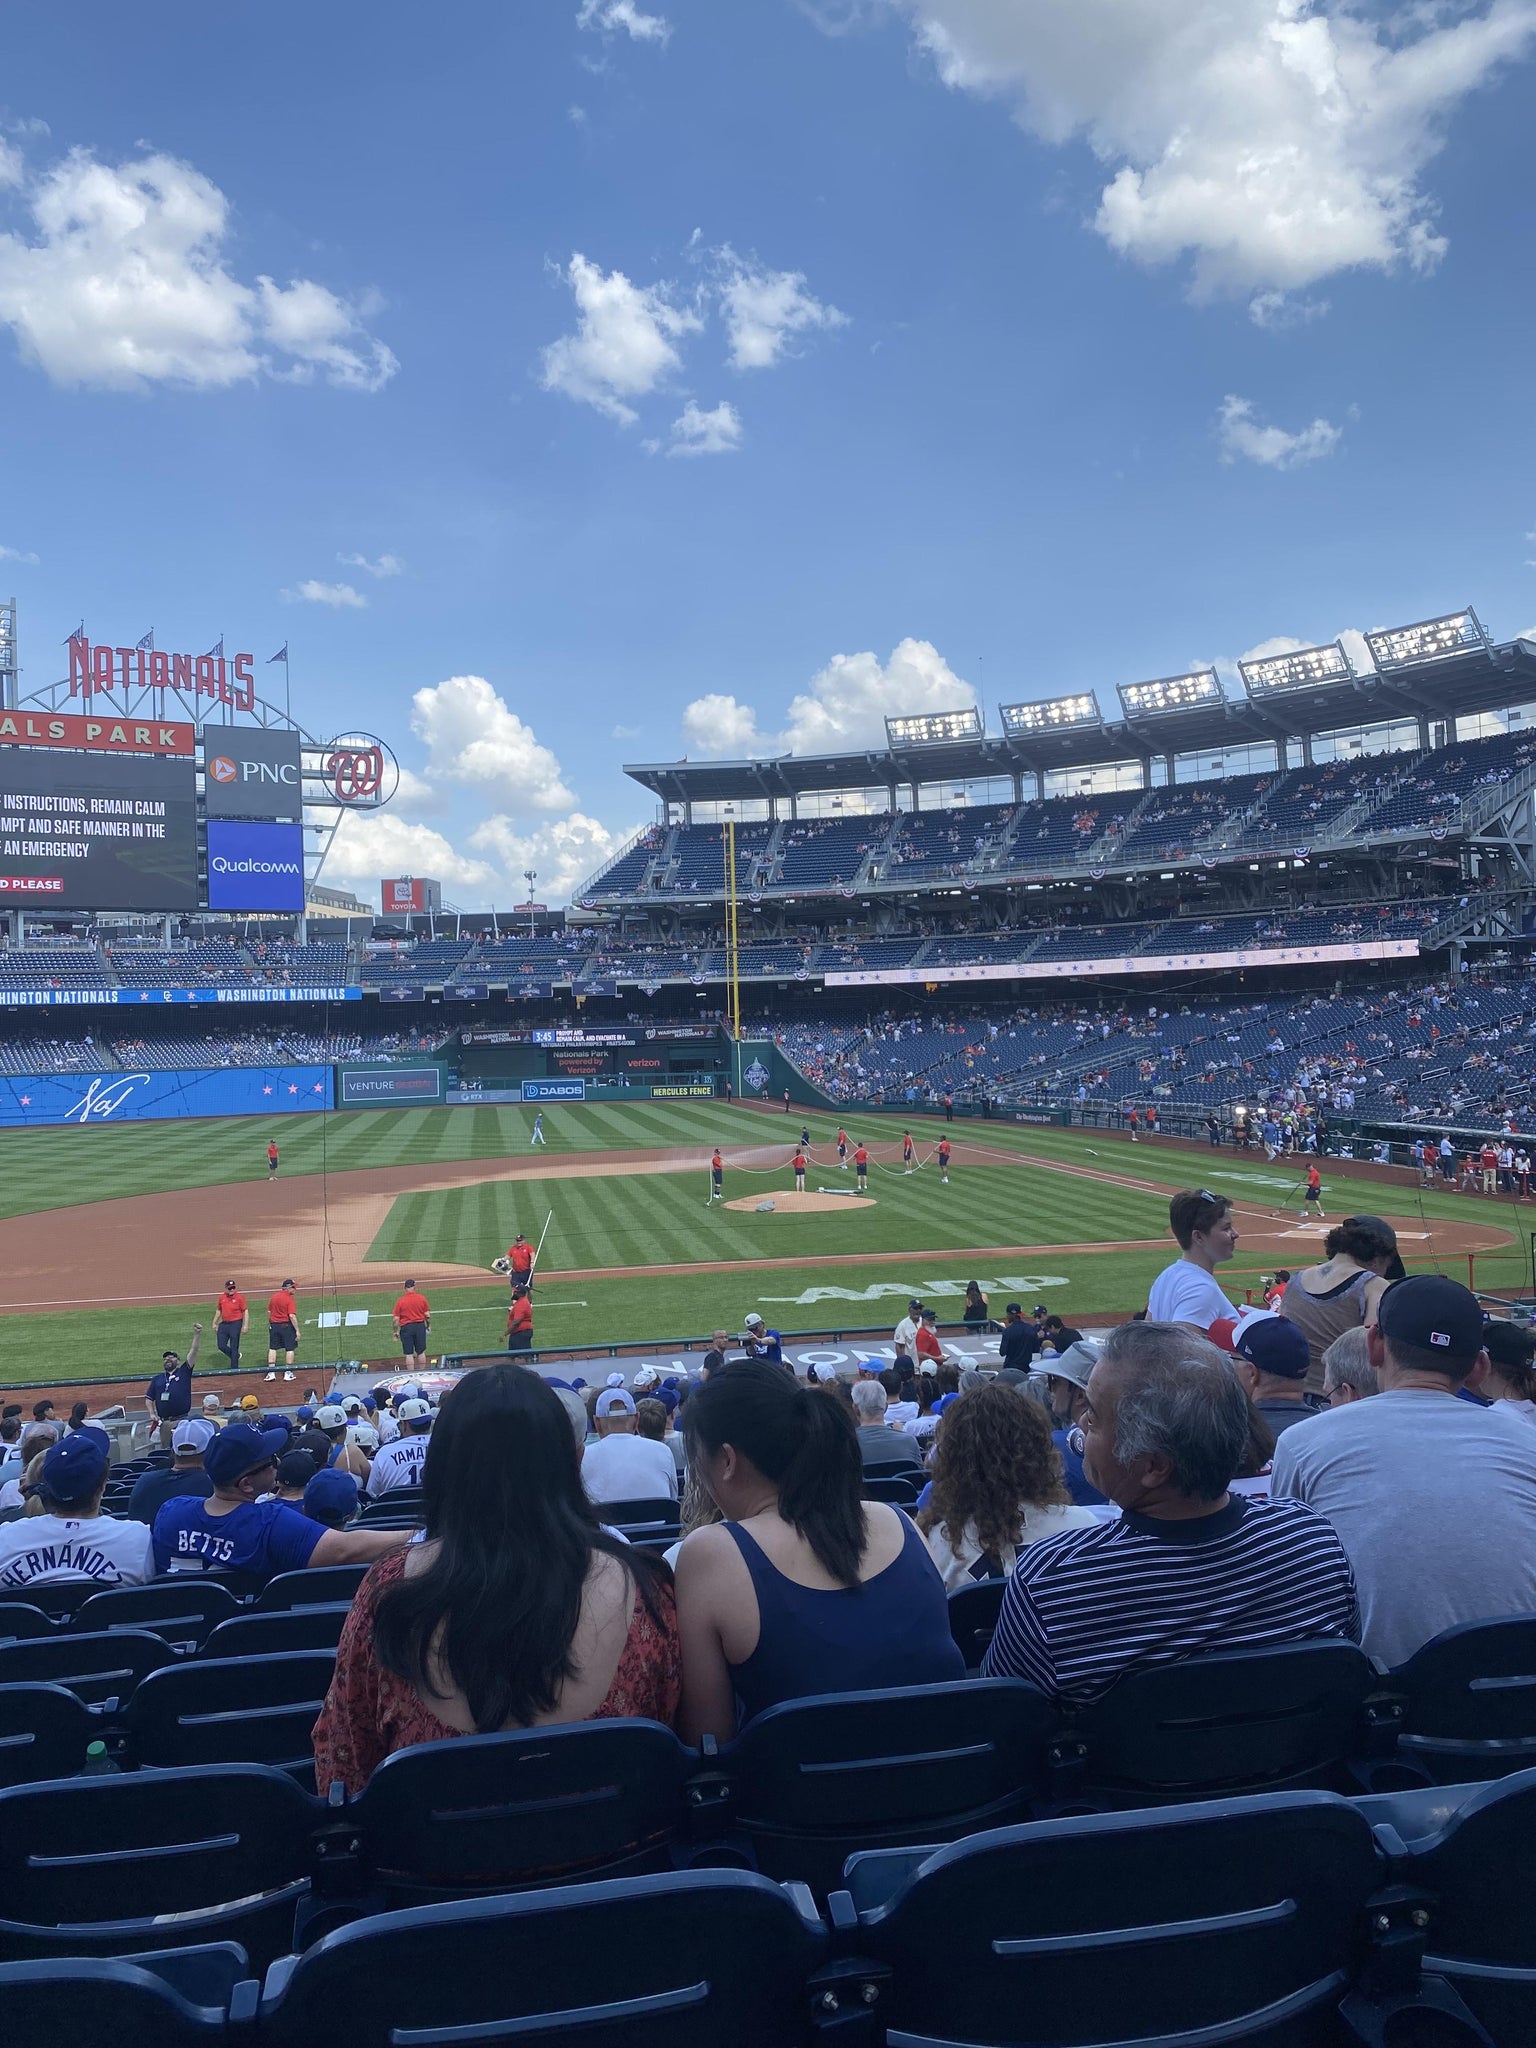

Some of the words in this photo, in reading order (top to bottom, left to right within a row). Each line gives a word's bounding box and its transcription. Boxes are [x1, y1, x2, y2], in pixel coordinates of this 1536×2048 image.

[69, 636, 255, 711] NATIONALS
[0, 717, 65, 739] ALS
[86, 723, 176, 746] PARK
[240, 761, 298, 784] PNC
[3, 794, 89, 815] INSTRUCTIONS,
[91, 799, 133, 815] REMAIN
[135, 801, 165, 816] CALM
[28, 818, 52, 834] AND
[54, 819, 81, 835] SAFE
[84, 821, 130, 837] MANNER
[132, 823, 144, 838] IN
[146, 823, 165, 838] THE
[4, 840, 21, 855] AN
[22, 841, 89, 858] EMERGENCY
[212, 857, 299, 874] Qualcomm
[12, 879, 61, 890] PLEASE
[55, 990, 118, 1003] NATIONALS
[217, 989, 286, 1002] WASHINGTON
[290, 988, 345, 1000] NATIONALS
[536, 1032, 552, 1042] 3:45
[553, 1049, 589, 1057] Nationals
[591, 1049, 609, 1057] Park
[559, 1058, 592, 1066] powered
[593, 1057, 604, 1066] by
[628, 1059, 660, 1067] verizon
[567, 1066, 596, 1074] Verizon
[350, 1081, 395, 1091] VENTURE
[540, 1086, 582, 1096] DABOS
[653, 1087, 687, 1096] HERCULES
[689, 1086, 711, 1095] FENCE
[391, 1446, 427, 1466] YAMA
[178, 1530, 235, 1561] BETTS
